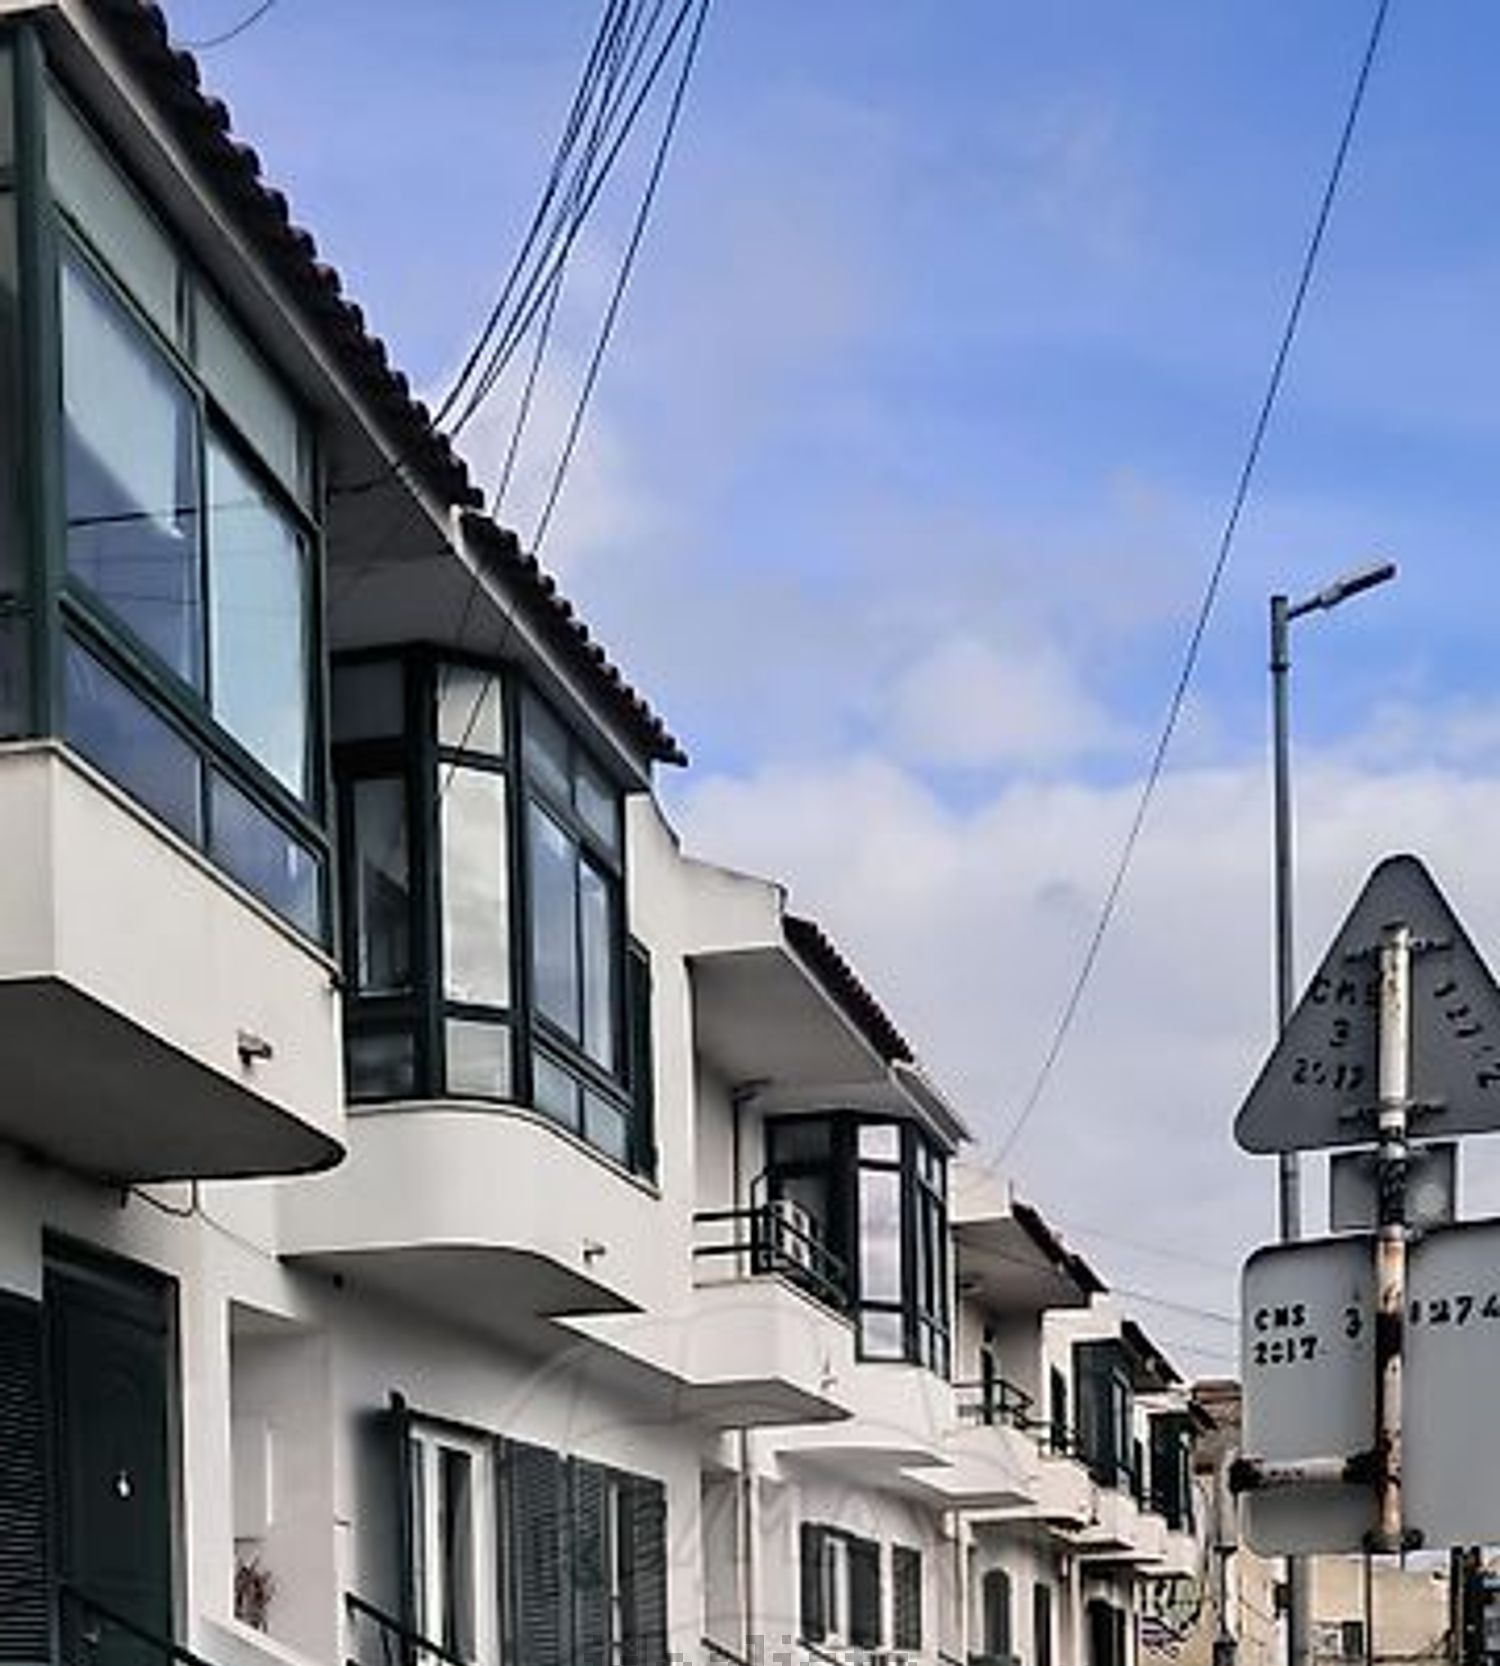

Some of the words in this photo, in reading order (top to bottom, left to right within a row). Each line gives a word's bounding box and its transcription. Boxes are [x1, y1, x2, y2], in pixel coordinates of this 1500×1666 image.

[1330, 1019, 1349, 1047] 3
[1344, 1307, 1363, 1339] 3
[1254, 1335, 1318, 1365] 2017
